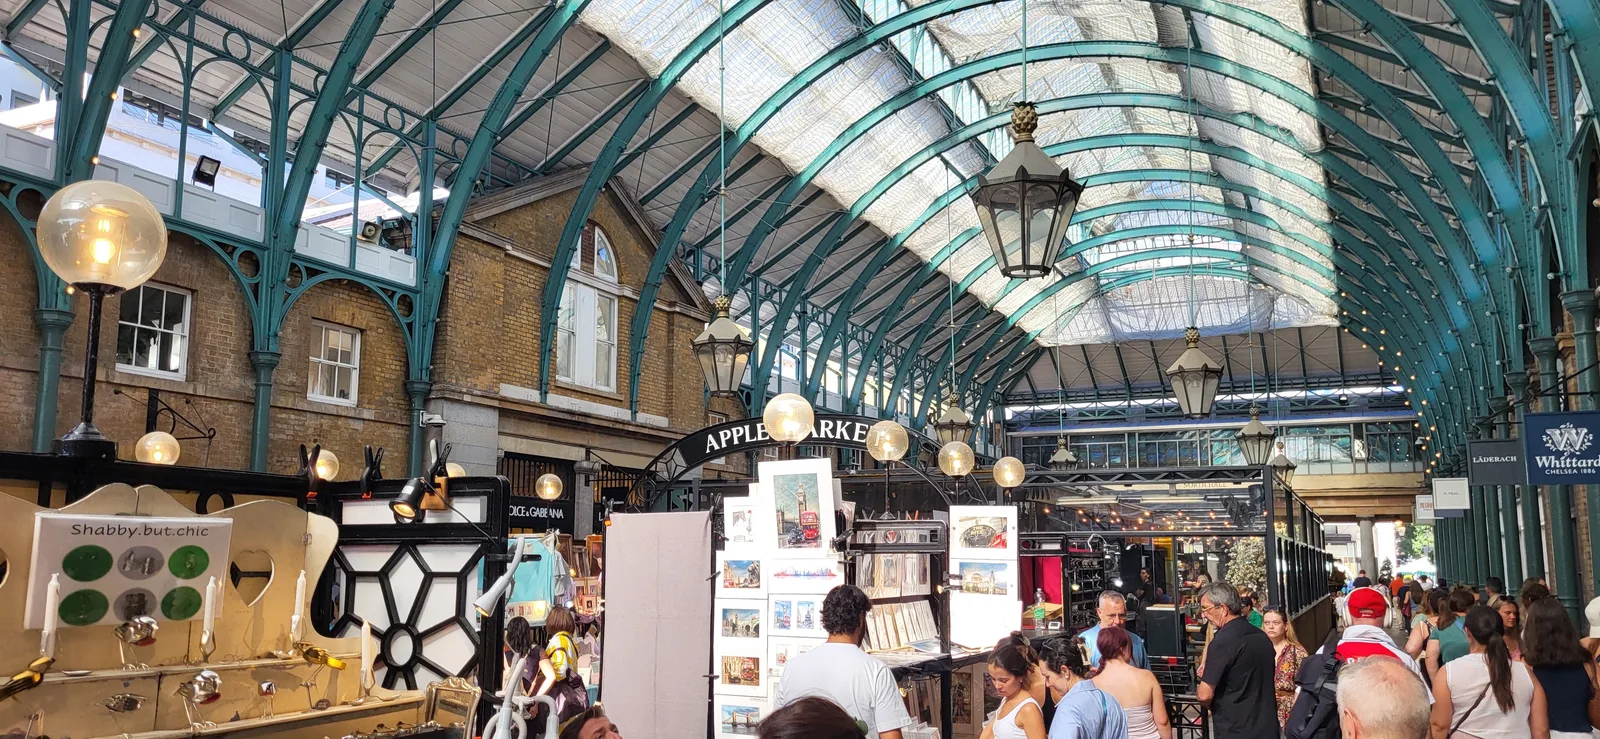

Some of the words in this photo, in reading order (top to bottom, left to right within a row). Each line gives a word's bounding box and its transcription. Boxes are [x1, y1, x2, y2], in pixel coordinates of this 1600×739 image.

[705, 424, 771, 453] APPLE
[783, 419, 888, 447] ARKET
[1535, 455, 1600, 469] Whittard
[509, 505, 564, 519] OLCE&GABBANA
[71, 523, 209, 538] Shabby.but.chic
